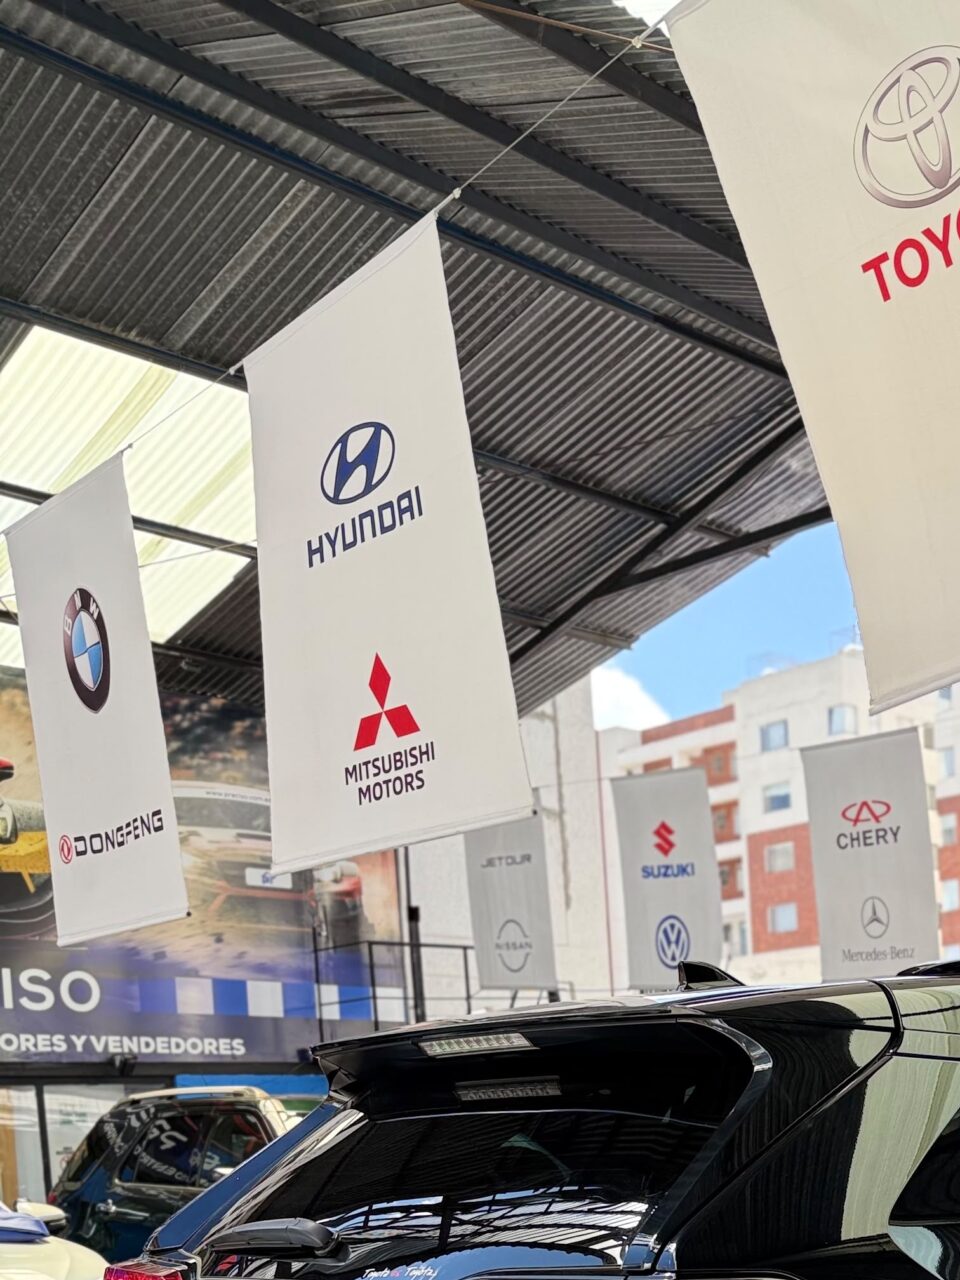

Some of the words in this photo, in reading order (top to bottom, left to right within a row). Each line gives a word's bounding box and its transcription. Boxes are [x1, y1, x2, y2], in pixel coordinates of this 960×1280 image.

[306, 485, 424, 568] HYUNDAI
[344, 741, 436, 786] MITSUBISHI
[357, 770, 426, 806] MOTORS
[73, 808, 164, 857] DONGFENG
[836, 825, 901, 850] CHERY
[481, 853, 532, 868] JETOUR
[641, 862, 695, 879] SUZUKI
[842, 946, 915, 962] Mercedes-Benz
[70, 1035, 88, 1052] Y
[90, 1036, 246, 1056] VENDEDORES
